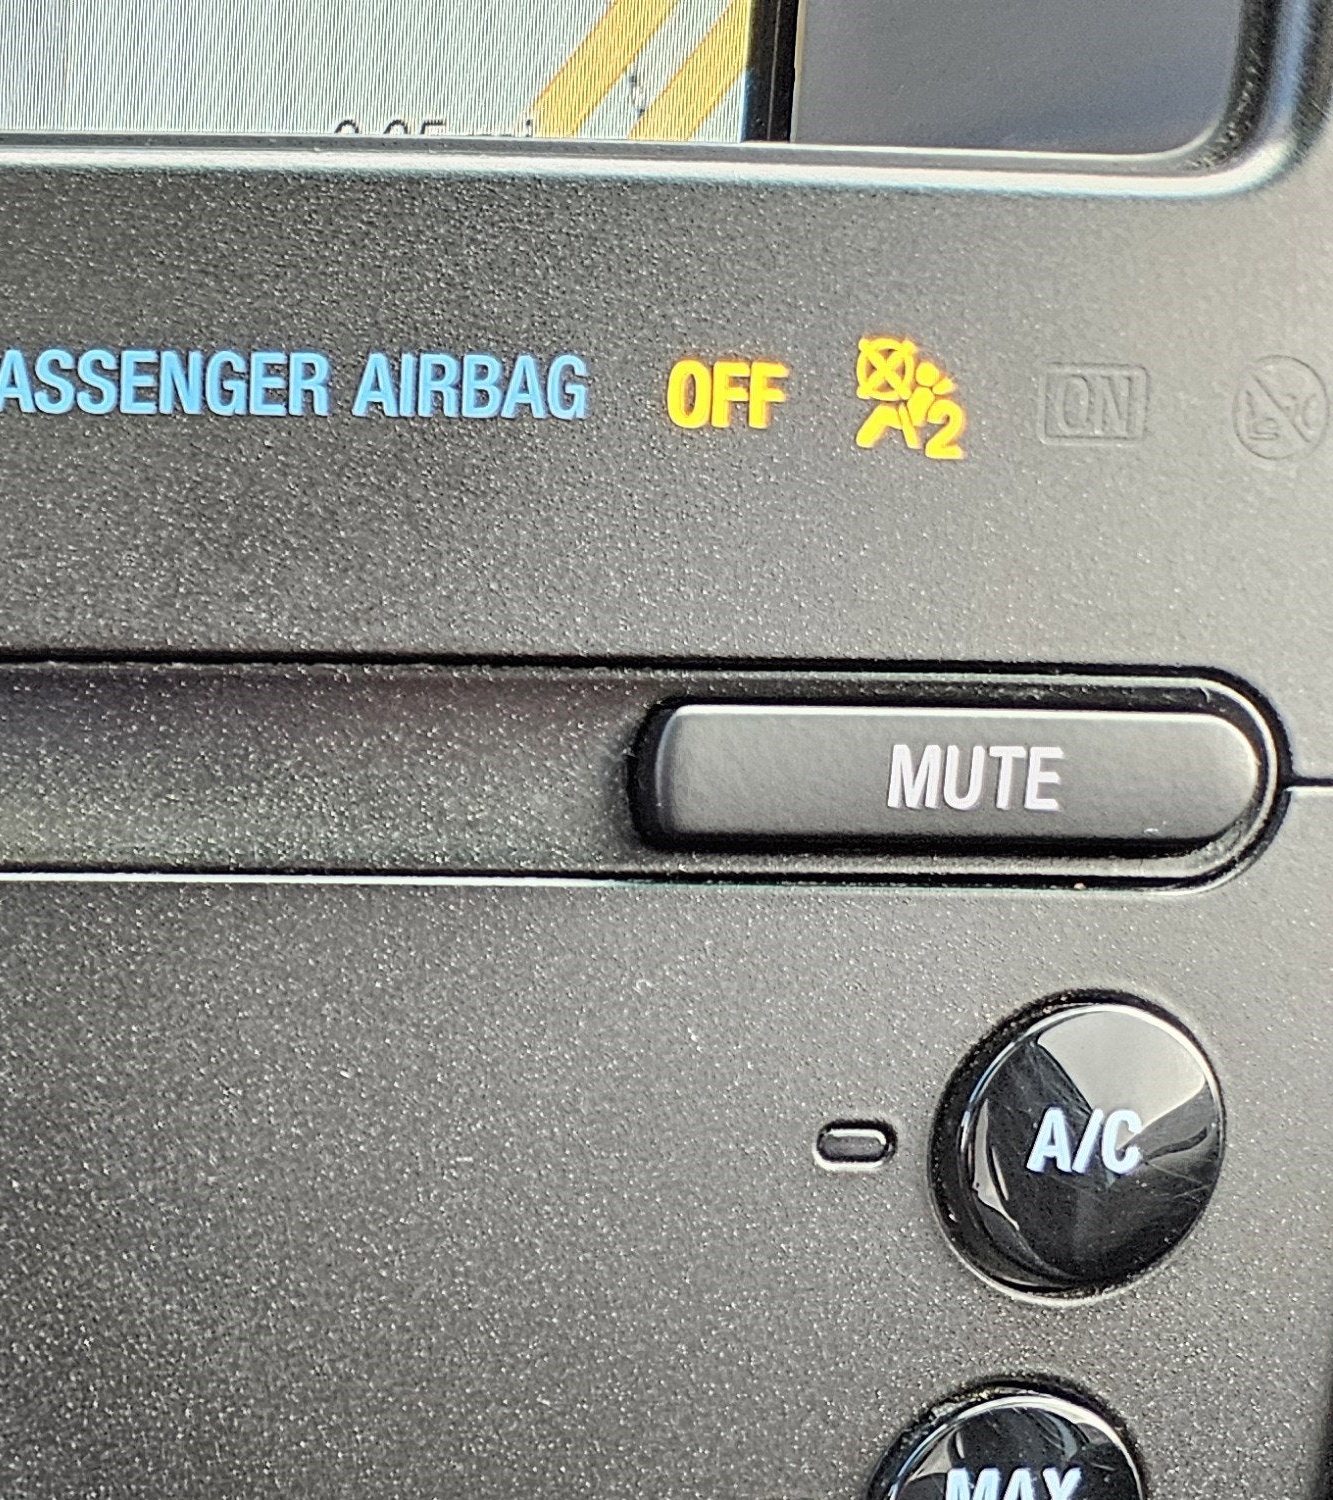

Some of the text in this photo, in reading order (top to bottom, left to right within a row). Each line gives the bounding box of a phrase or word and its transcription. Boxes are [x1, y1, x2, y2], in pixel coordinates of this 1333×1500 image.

[351, 352, 589, 421] AIRBAG
[666, 359, 789, 429] OFF
[887, 743, 1064, 811] MUTE
[1026, 1106, 1143, 1175] A/C
